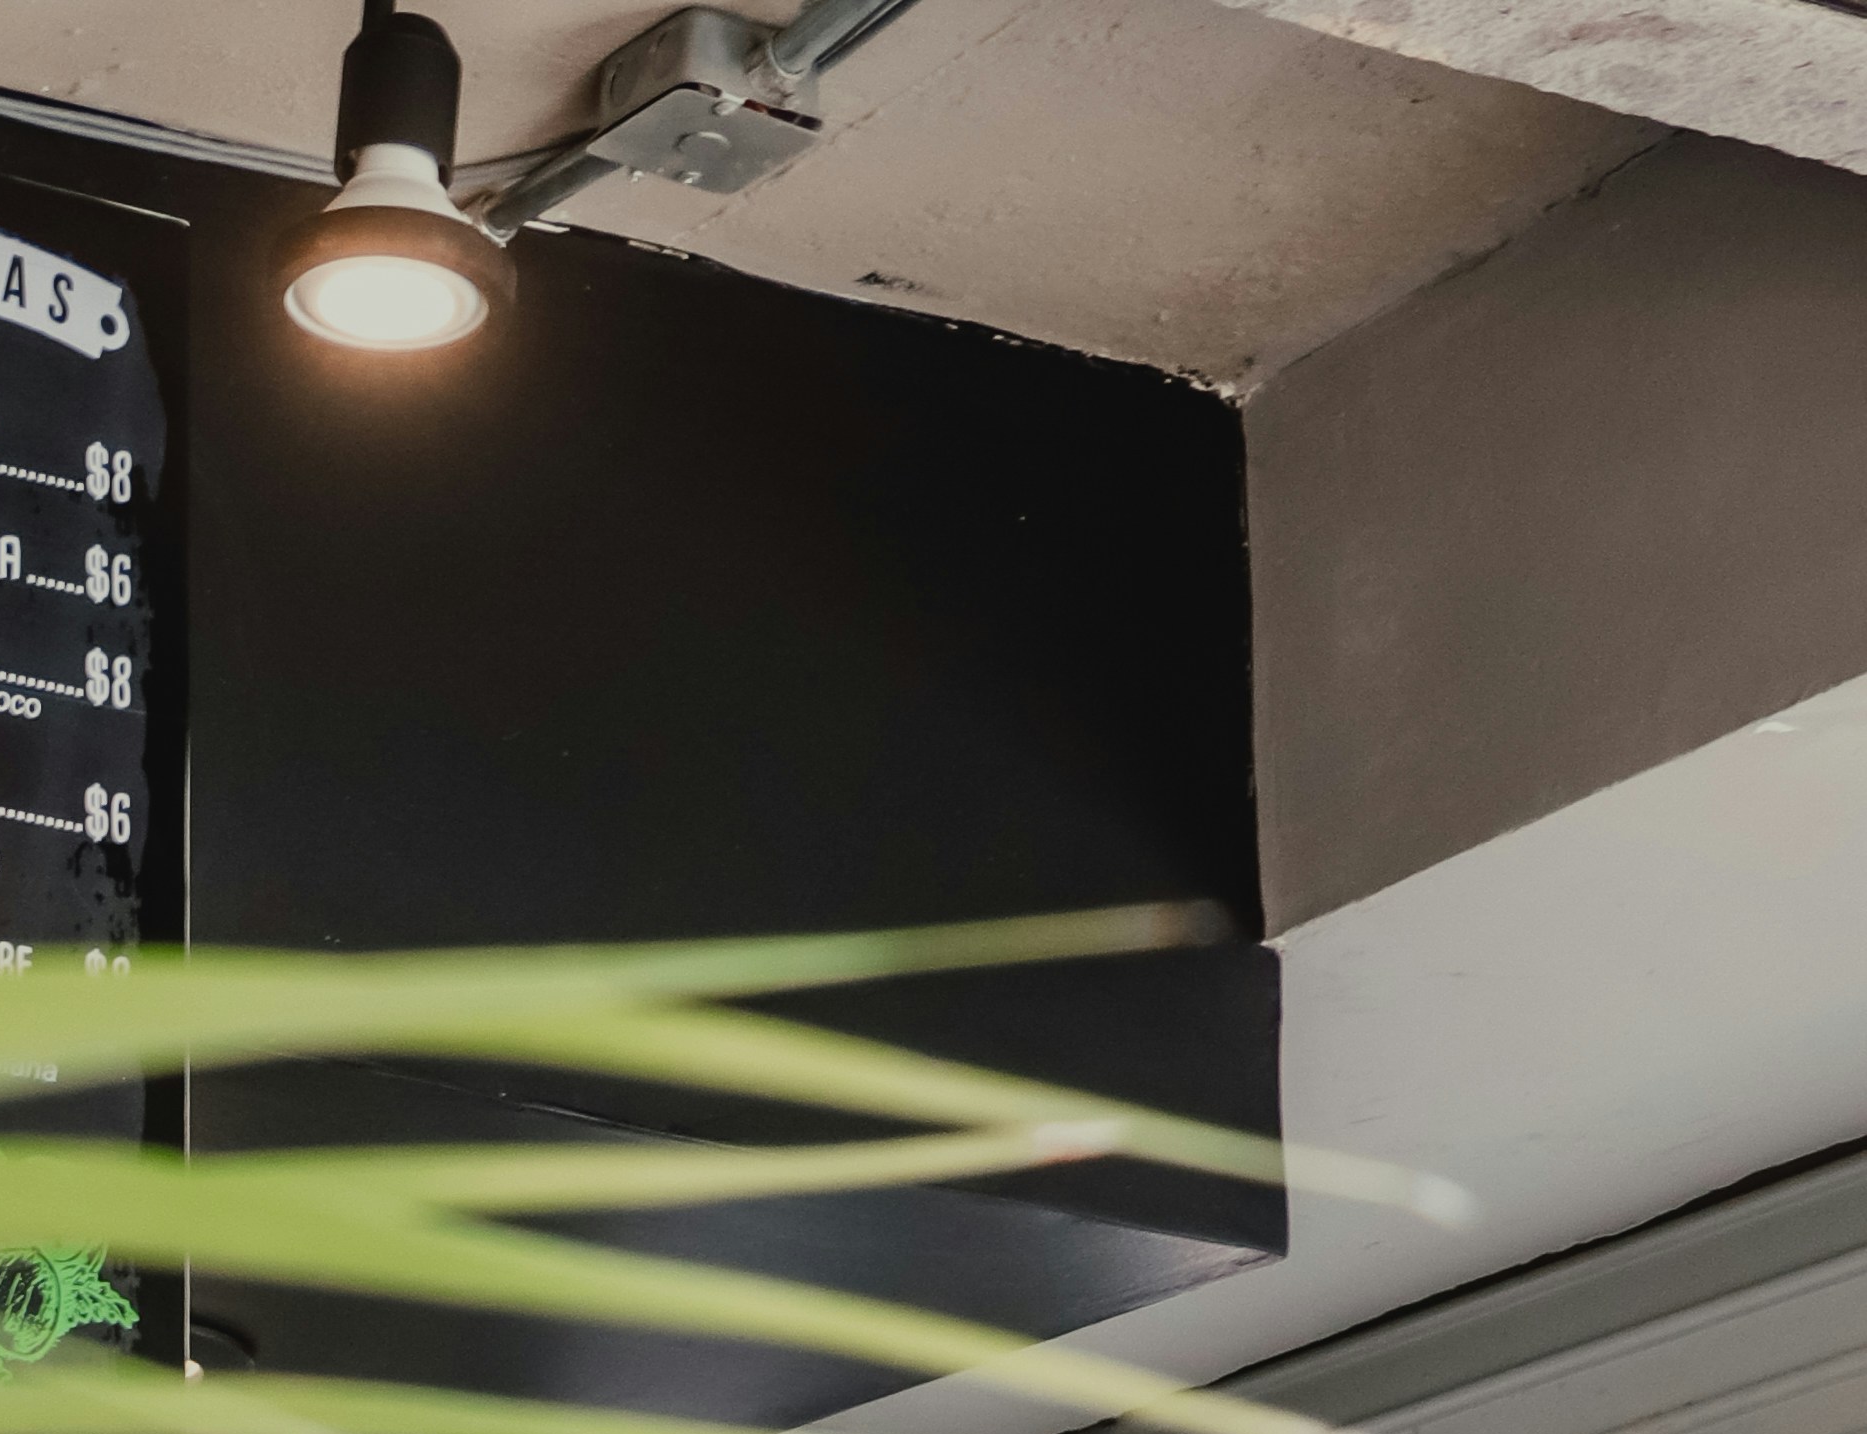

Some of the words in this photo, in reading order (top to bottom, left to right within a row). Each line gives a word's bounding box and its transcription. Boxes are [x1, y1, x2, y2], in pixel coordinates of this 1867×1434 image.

[85, 442, 133, 504] $8
[85, 546, 132, 607] $6
[85, 649, 132, 710] $8
[85, 784, 132, 843] $6
